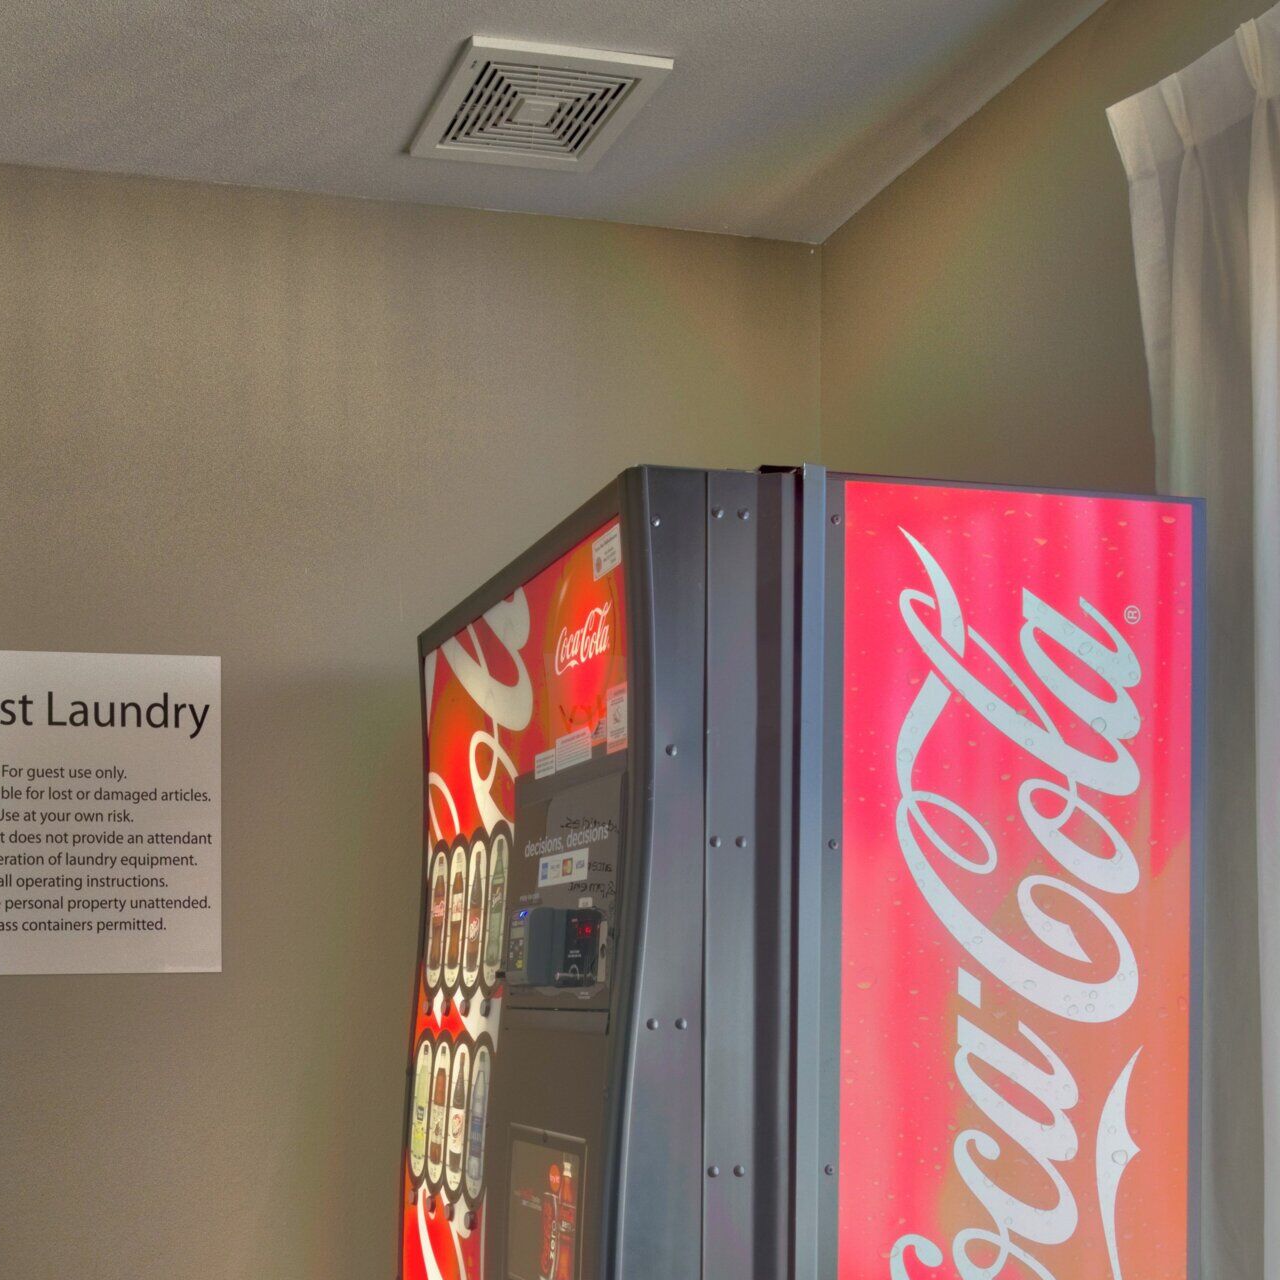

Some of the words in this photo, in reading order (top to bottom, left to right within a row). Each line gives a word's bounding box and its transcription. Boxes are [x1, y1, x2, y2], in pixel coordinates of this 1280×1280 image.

[555, 601, 611, 676] Coca-Cola
[48, 691, 210, 739] Laundry
[2, 765, 23, 777] For
[27, 767, 65, 781] guest
[69, 769, 92, 778] use
[95, 765, 127, 782] only.
[26, 786, 45, 800] for
[49, 787, 73, 800] lost
[76, 791, 90, 800] or
[94, 787, 157, 804] damaged
[161, 788, 211, 802] articles.
[23, 810, 36, 822] at
[40, 812, 71, 825] your
[74, 812, 103, 822] own
[108, 809, 133, 823] risk.
[9, 830, 41, 843] does
[46, 833, 68, 844] not
[73, 831, 124, 847] provide
[127, 835, 143, 844] an
[147, 831, 212, 844] attendant
[525, 836, 563, 858] decisions,
[567, 825, 608, 848] decisions
[48, 852, 62, 865] of
[66, 852, 117, 869] laundry
[120, 853, 197, 869] equipment.
[16, 875, 82, 891] operating
[87, 875, 168, 887] instructions.
[5, 896, 63, 912] personal
[68, 898, 126, 912] property
[130, 896, 211, 909] unattended.
[22, 918, 93, 931] containers
[97, 917, 166, 934] permitted.
